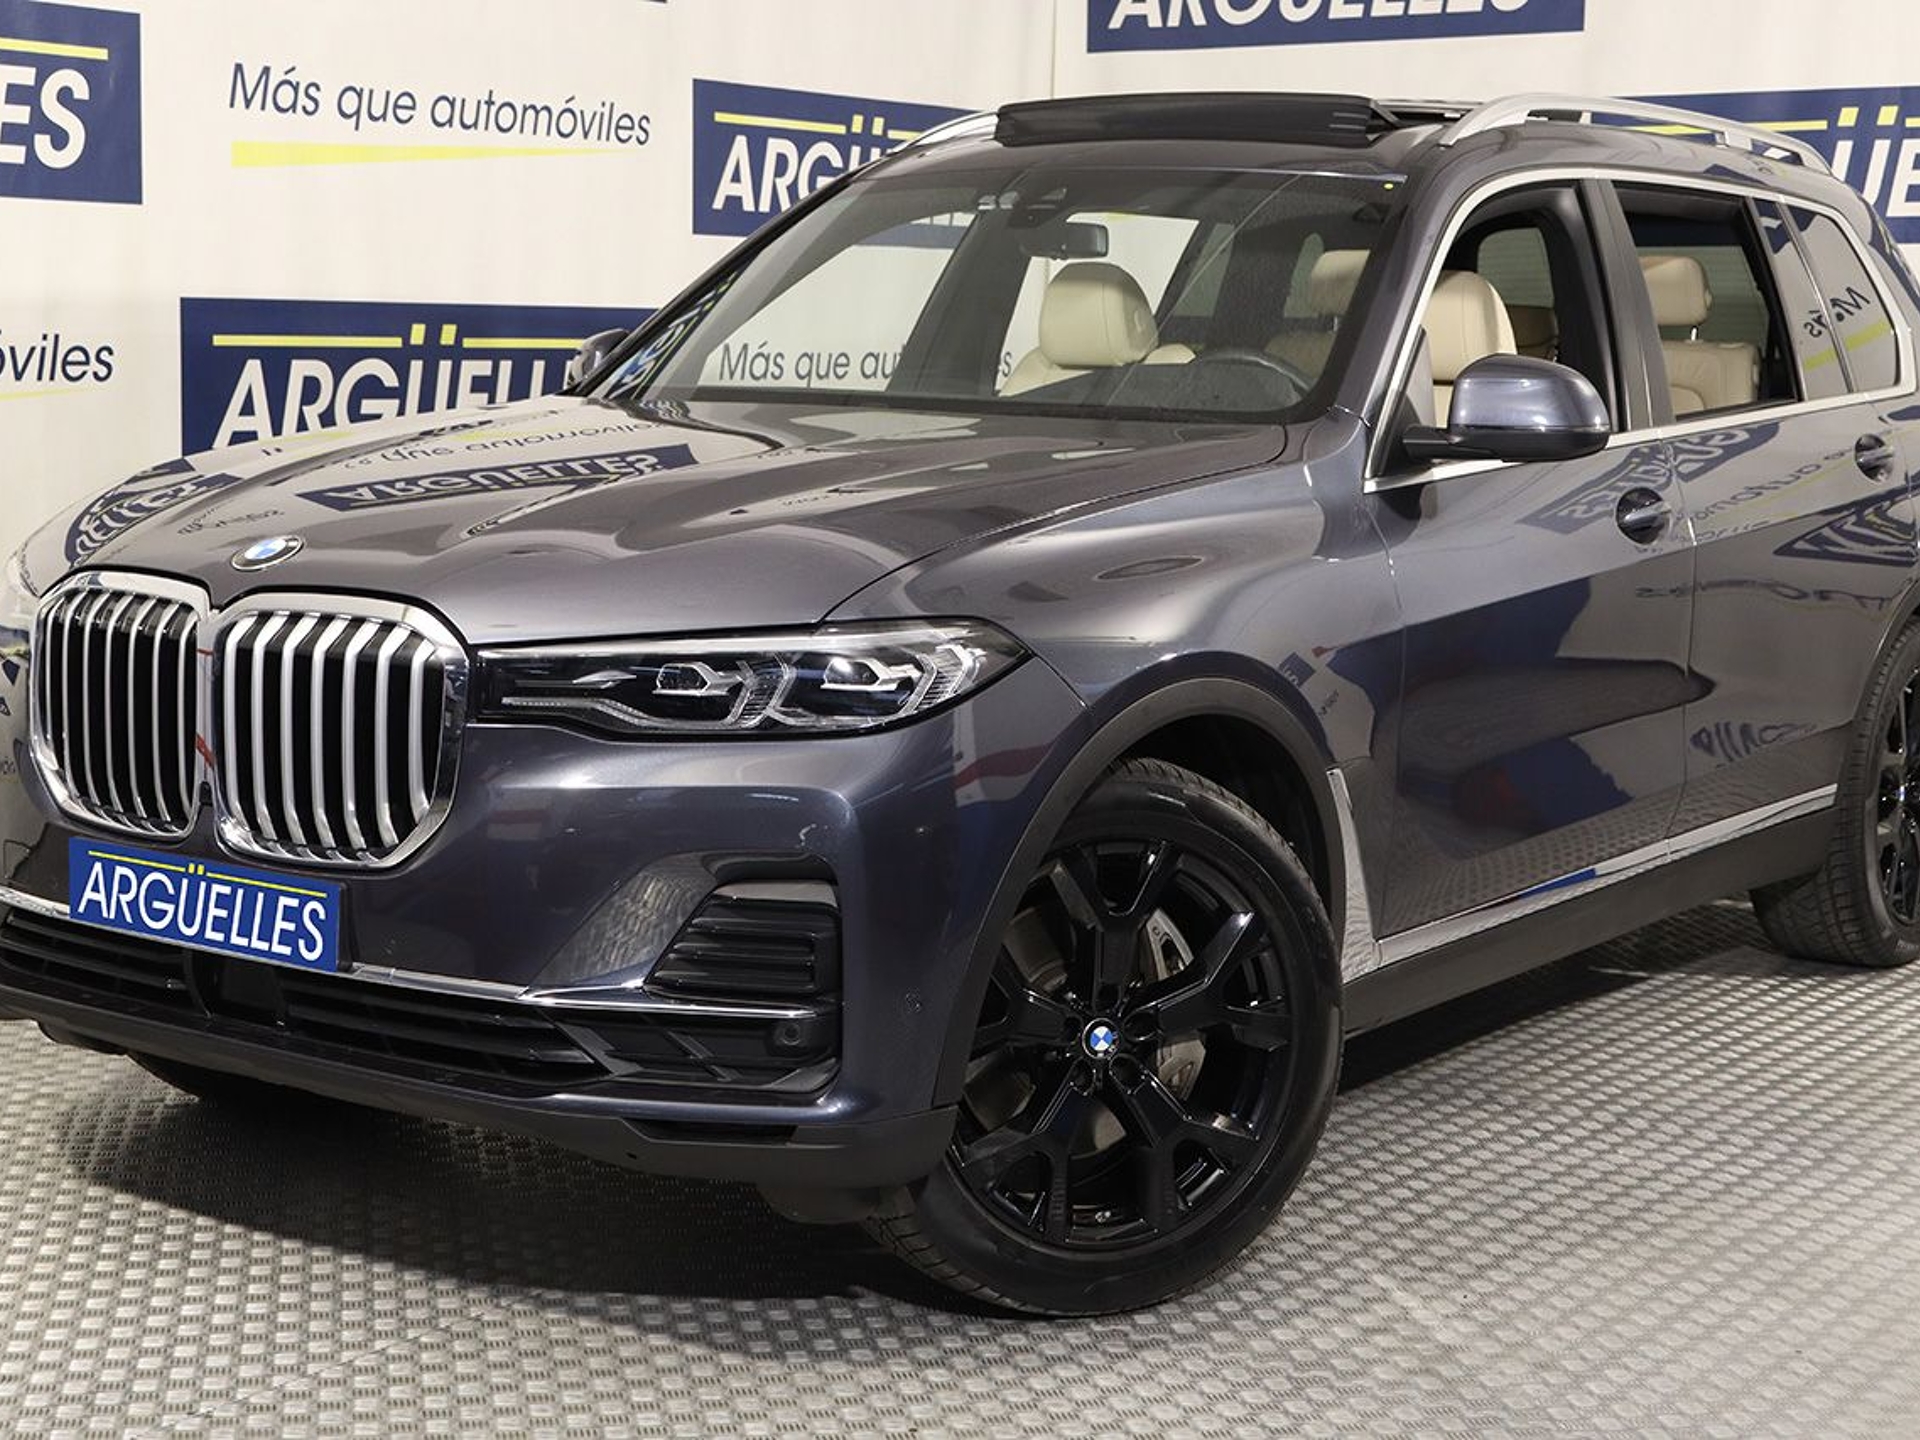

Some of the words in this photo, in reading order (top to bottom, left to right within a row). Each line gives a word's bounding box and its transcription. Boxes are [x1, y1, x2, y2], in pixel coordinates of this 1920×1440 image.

[228, 62, 321, 116] Más
[336, 84, 417, 131] que
[430, 89, 651, 146] automóviles
[0, 329, 114, 382] viles
[718, 341, 785, 381] Más
[794, 350, 850, 389] que
[77, 861, 327, 962] ARGÜELLES
